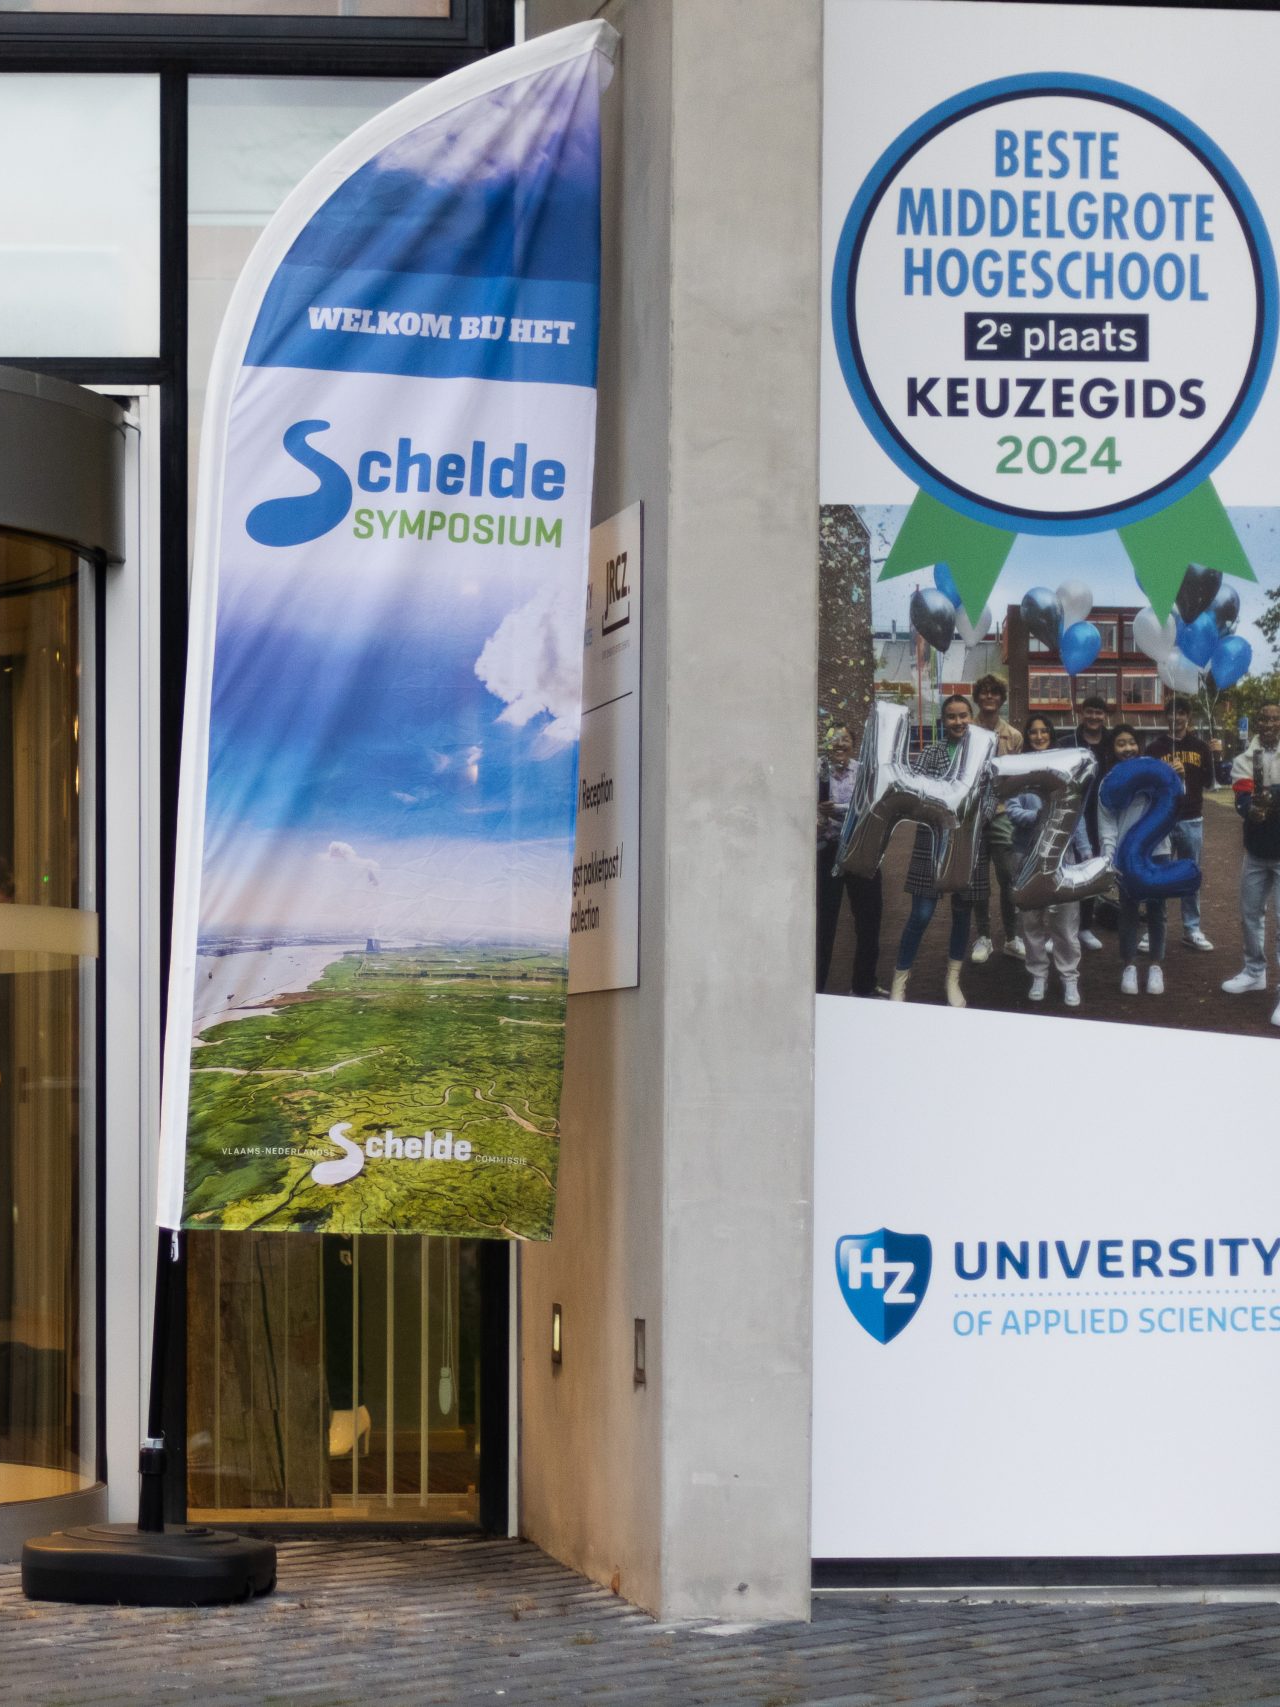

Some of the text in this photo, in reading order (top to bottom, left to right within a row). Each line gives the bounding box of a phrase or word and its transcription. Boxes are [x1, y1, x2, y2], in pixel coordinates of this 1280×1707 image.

[993, 128, 1120, 180] BESTE
[895, 186, 1215, 242] MIDDELGROTE
[902, 246, 1209, 302] HOGESCHOOL
[308, 305, 576, 346] WELKOM BIJ HET
[1023, 319, 1138, 359] plaats
[906, 376, 1208, 420] KEUZEGIDS
[994, 434, 1123, 475] 2024
[245, 418, 567, 548] Schelde
[352, 507, 564, 549] SYMPOSIUM
[582, 770, 614, 815] Reception
[583, 846, 619, 895] pakketpost
[570, 898, 600, 934] collection
[311, 1121, 473, 1185] Schelde
[474, 1154, 528, 1167] COMMISSIE
[953, 1237, 1280, 1281] UNIVERSITY
[952, 1309, 993, 1337] OF
[1000, 1307, 1130, 1336] APPLIED
